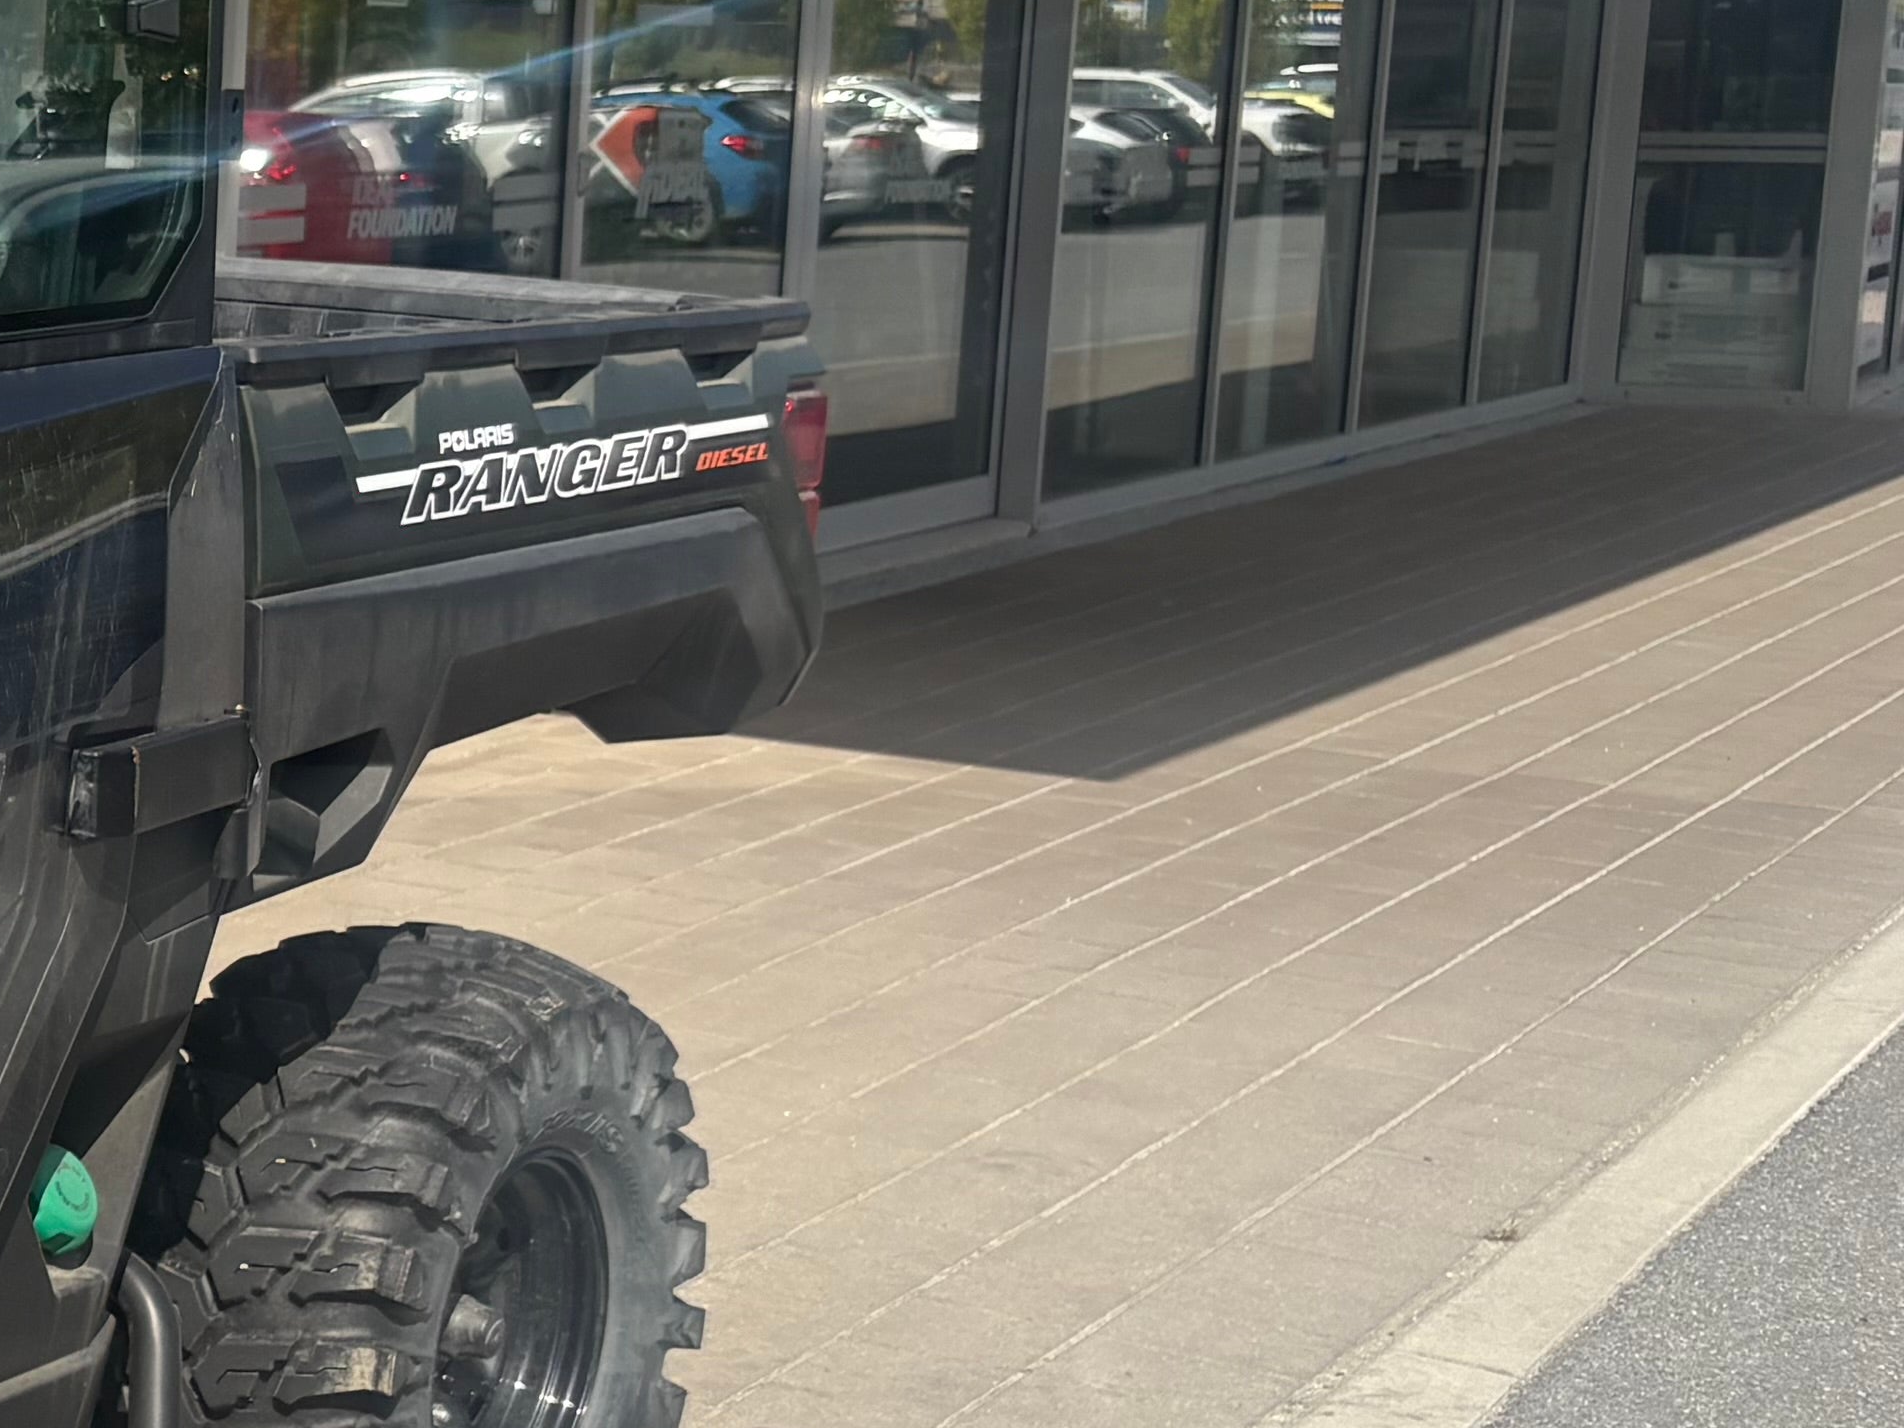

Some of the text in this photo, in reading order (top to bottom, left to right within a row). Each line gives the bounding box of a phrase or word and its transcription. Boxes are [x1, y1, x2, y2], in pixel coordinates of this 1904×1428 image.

[347, 205, 458, 239] FOUNDATION
[438, 422, 515, 455] POLARIS
[400, 424, 769, 527] RANGER DIESEL
